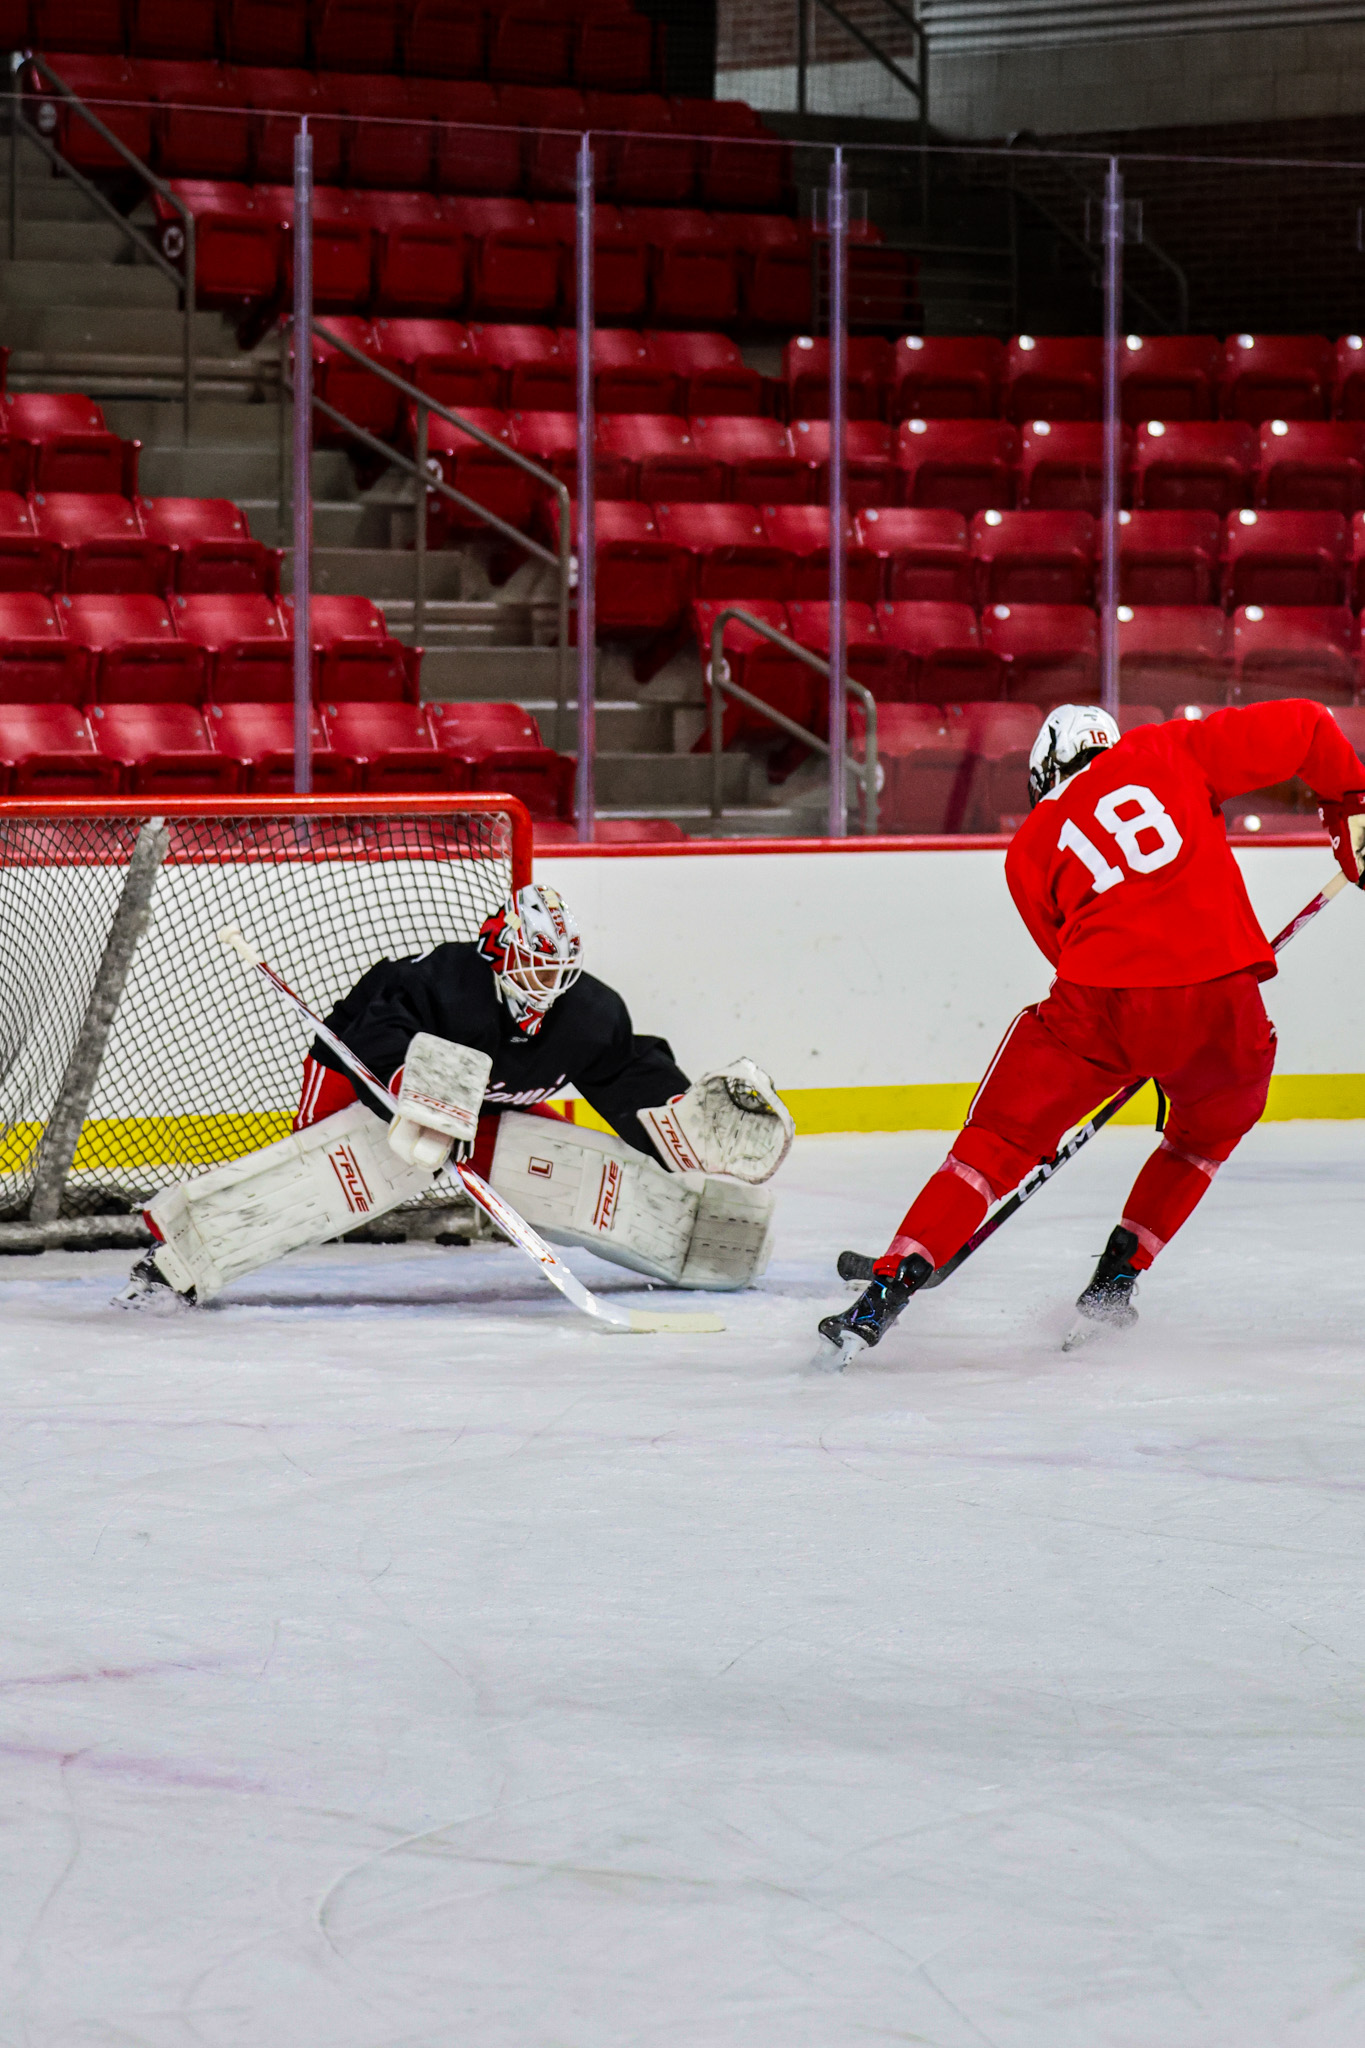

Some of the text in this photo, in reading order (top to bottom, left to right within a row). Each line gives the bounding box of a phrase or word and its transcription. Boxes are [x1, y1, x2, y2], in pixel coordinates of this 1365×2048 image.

[1057, 784, 1183, 894] 18
[661, 1115, 694, 1169] TRUE
[1018, 1120, 1096, 1202] CCM
[335, 1144, 370, 1212] TRUE
[599, 1160, 619, 1231] TRUE
